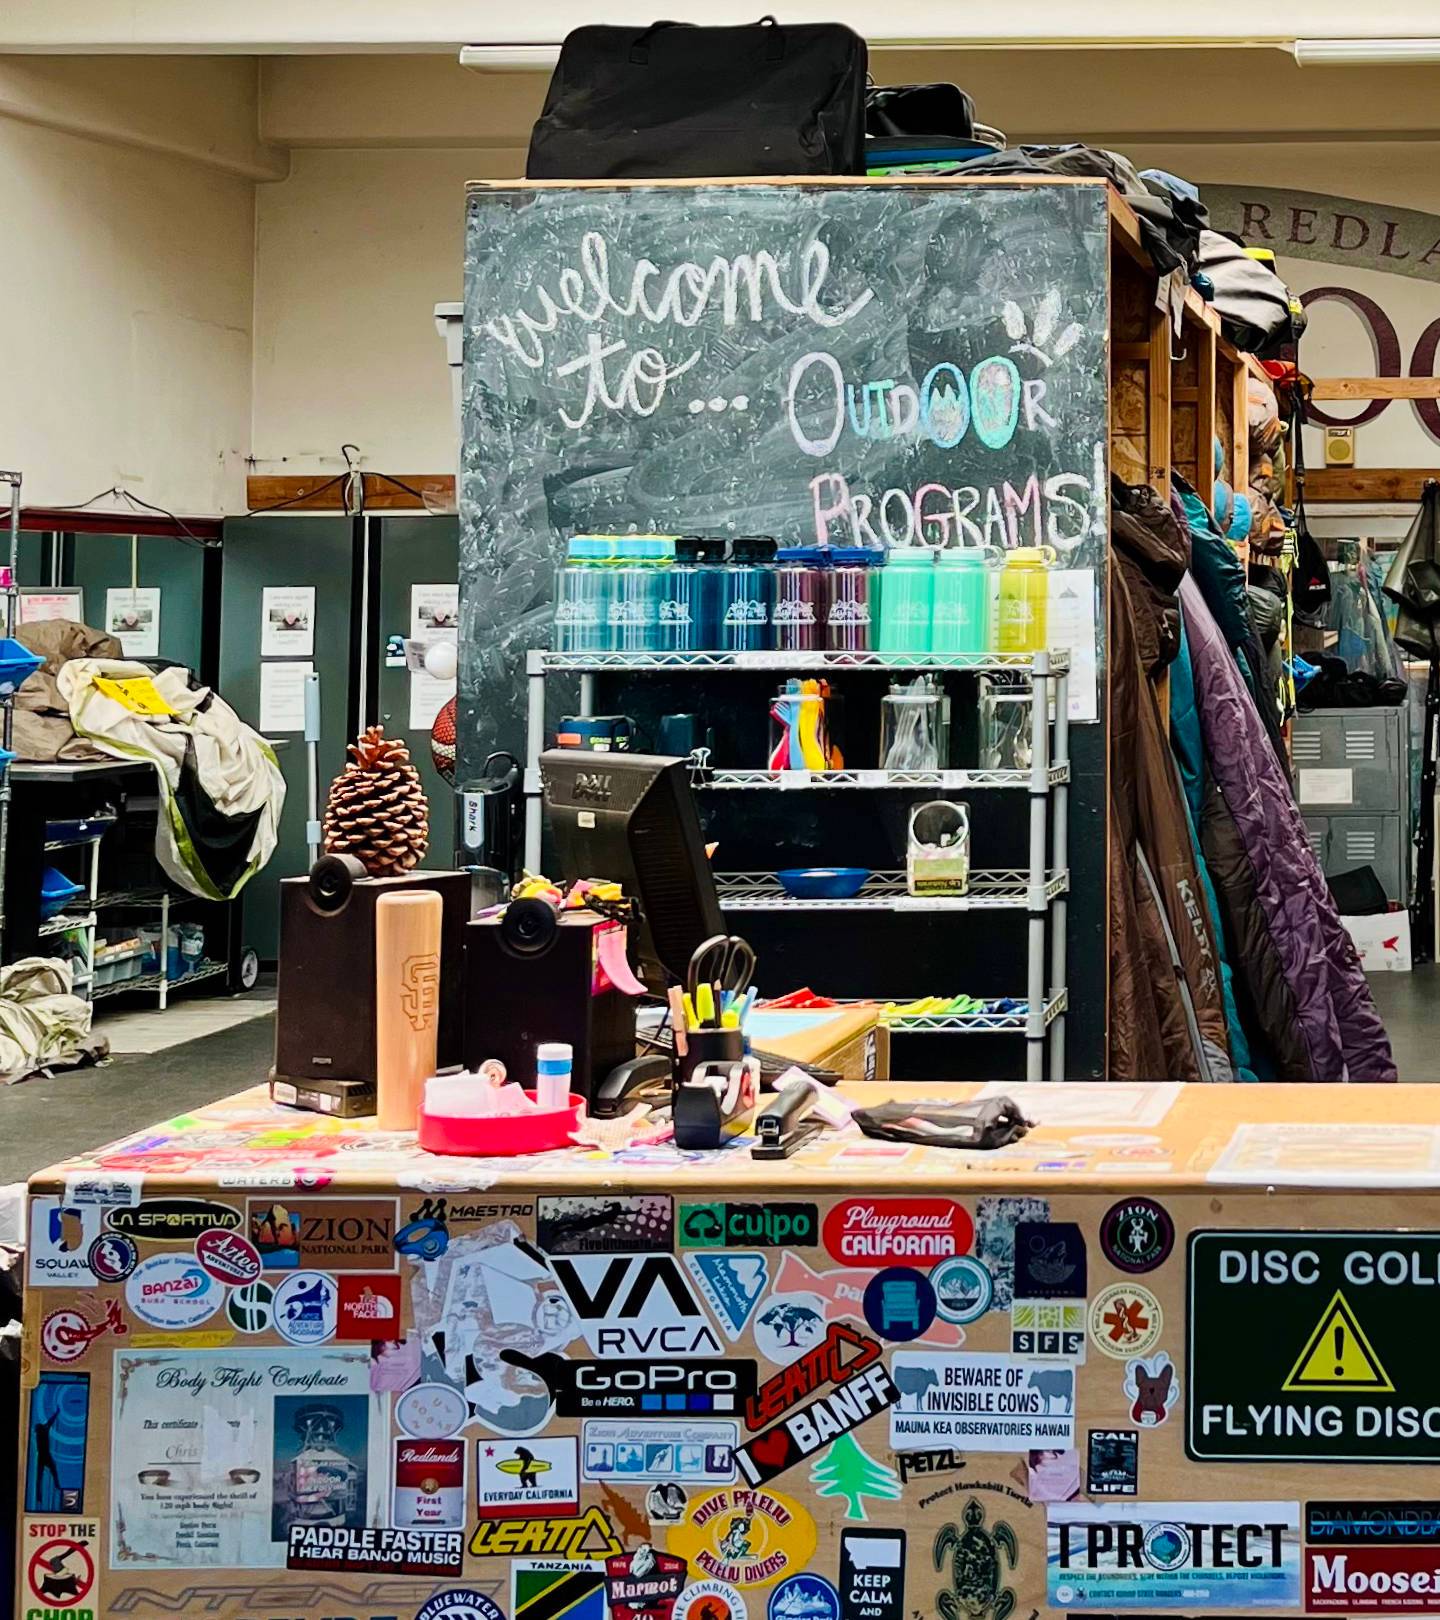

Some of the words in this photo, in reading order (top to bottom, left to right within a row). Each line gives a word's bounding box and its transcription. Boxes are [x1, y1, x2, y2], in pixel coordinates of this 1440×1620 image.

[450, 1204, 534, 1217] MAESTRO
[1116, 1206, 1158, 1222] ZION
[109, 1213, 133, 1226] LA
[138, 1213, 236, 1226] SPORTIVA
[844, 1206, 954, 1234] Playground
[302, 1218, 391, 1242] ZION
[206, 1235, 259, 1273] Aztec
[302, 1245, 358, 1255] NATIONAL
[362, 1245, 390, 1255] PARK
[841, 1235, 955, 1256] CALIFORNIA
[1220, 1250, 1320, 1285] DISC
[344, 1303, 378, 1311] NORTH
[598, 1326, 720, 1353] RVCA
[156, 1368, 206, 1396] Body
[211, 1367, 262, 1395] Flight
[268, 1366, 348, 1392] Certificate
[576, 1366, 736, 1390] GoPro
[945, 1367, 1001, 1387] BEWARE
[1006, 1369, 1023, 1387] OF
[786, 1365, 890, 1454] BANFF
[927, 1394, 994, 1412] INVISIBLE
[998, 1395, 1039, 1413] COWS
[895, 1421, 930, 1434] MAUNA
[933, 1422, 952, 1434] KEA
[955, 1422, 1032, 1435] OBSERVATORIES
[1035, 1424, 1070, 1436] HAWAII
[1202, 1405, 1343, 1437] FLYING
[1091, 1432, 1136, 1441] CALI
[165, 1444, 197, 1459] Chris
[399, 1447, 460, 1464] Redlands
[484, 1491, 523, 1501] EVERYDAY
[525, 1490, 573, 1500] CALIFORNIA
[1090, 1483, 1135, 1493] LIFE
[416, 1496, 441, 1505] First
[417, 1508, 441, 1518] Year
[29, 1524, 66, 1537] STOP
[69, 1524, 96, 1537] THE
[290, 1527, 374, 1549] PADDLE
[381, 1531, 462, 1553] FASTER
[1059, 1524, 1070, 1568] I
[299, 1547, 343, 1561] HEAR
[348, 1549, 403, 1563] BANJO
[407, 1551, 460, 1566] MUSIC
[531, 1562, 592, 1571] TANZANIA
[744, 1551, 788, 1581] DIVERS
[612, 1578, 678, 1598] Marmot
[854, 1574, 890, 1587] KEEP
[850, 1590, 892, 1604] CALM
[860, 1607, 881, 1616] AND
